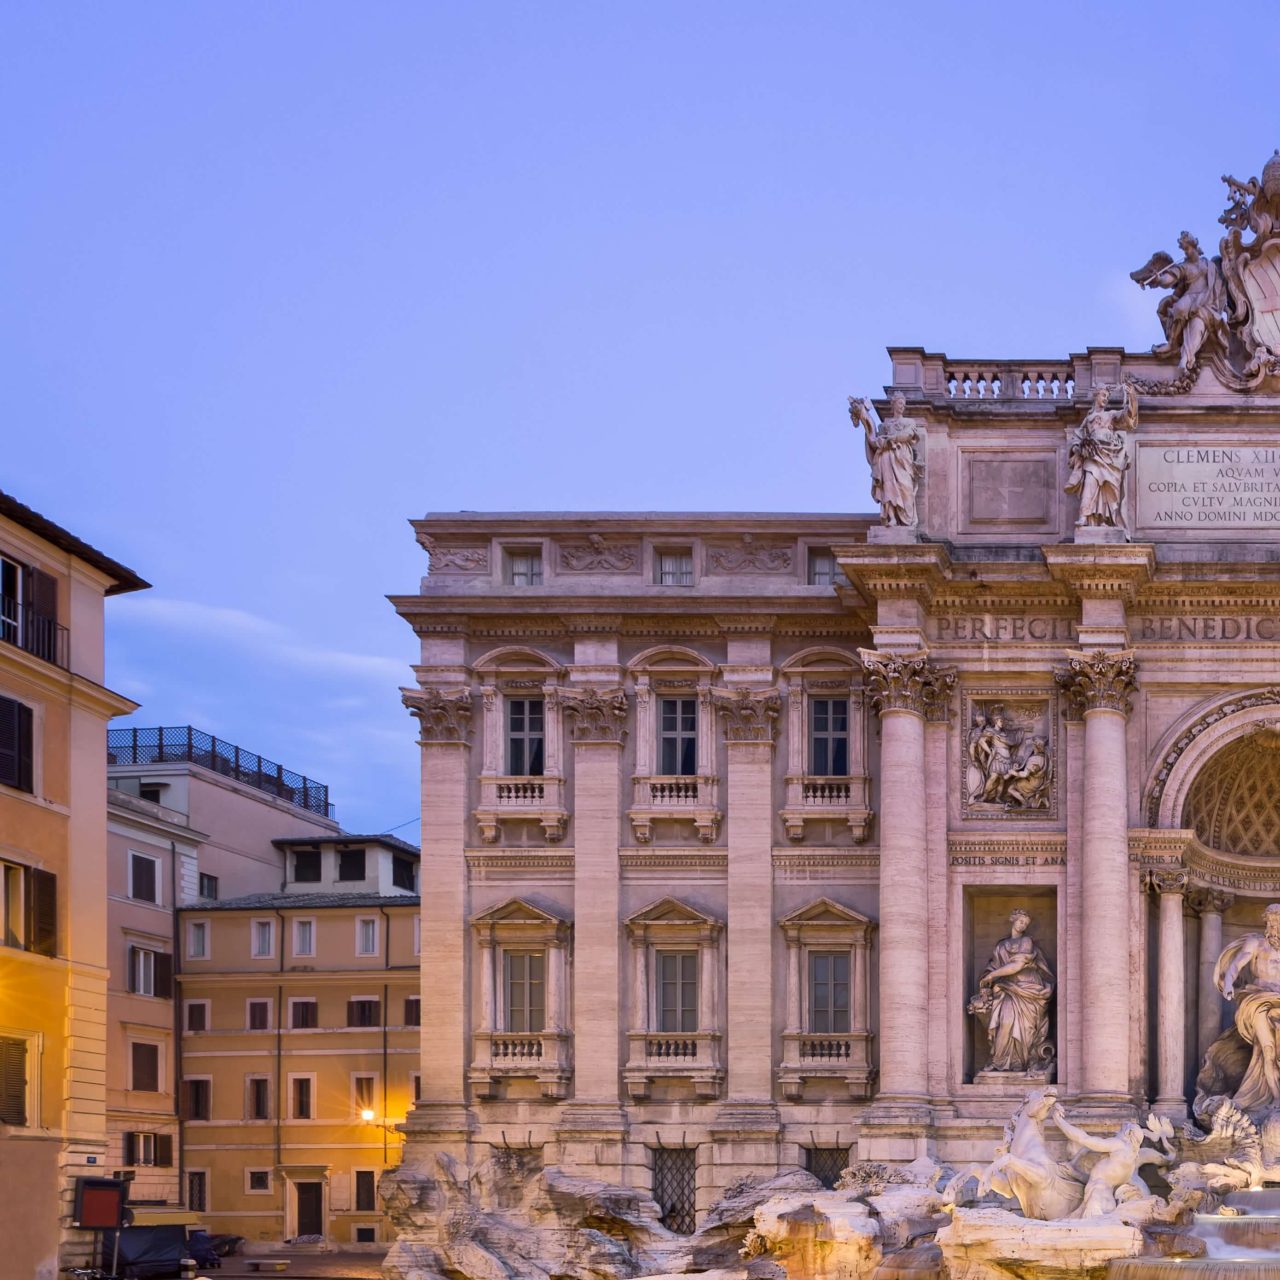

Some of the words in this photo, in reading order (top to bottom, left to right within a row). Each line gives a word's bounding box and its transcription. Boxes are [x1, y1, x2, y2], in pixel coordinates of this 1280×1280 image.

[1163, 450, 1242, 463] CLEMENS
[1216, 467, 1265, 480] AQVAM
[1148, 482, 1188, 493] COPIA
[1193, 482, 1208, 493] ET
[1181, 496, 1225, 507] CVLTV
[1153, 511, 1193, 521] ANNO
[1198, 511, 1247, 521] DOMINI
[935, 617, 1077, 640] PERFECIT
[951, 856, 986, 866] POSITIS
[990, 856, 1020, 866] SIGNIS
[1025, 856, 1038, 866] ET
